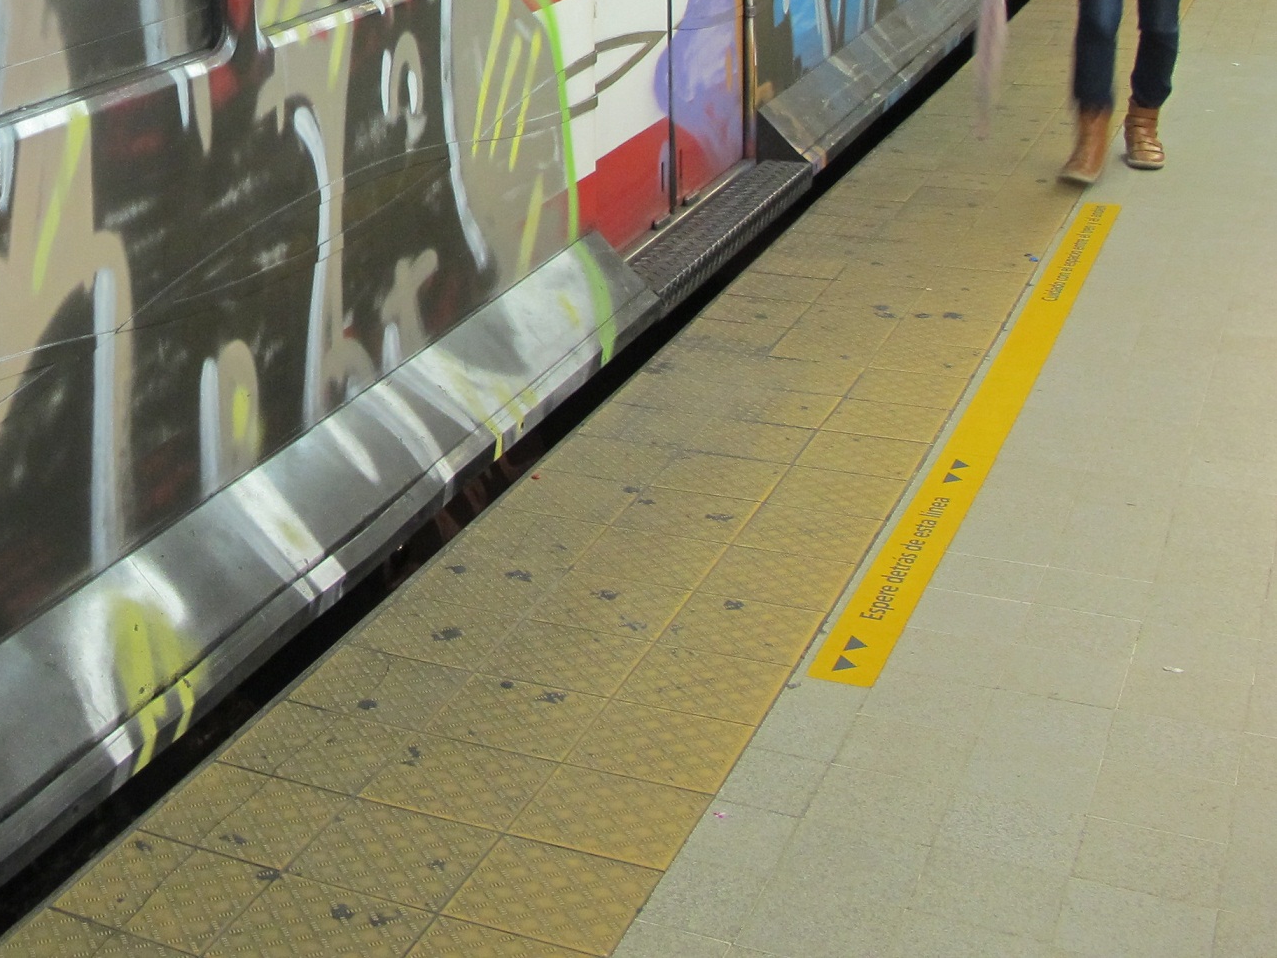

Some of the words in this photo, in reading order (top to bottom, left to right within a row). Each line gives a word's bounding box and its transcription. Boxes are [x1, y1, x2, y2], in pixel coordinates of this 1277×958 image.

[919, 497, 950, 518] línea
[914, 519, 937, 538] esta
[900, 539, 926, 552] de
[881, 553, 917, 584] detrás
[859, 585, 899, 621] Espere
